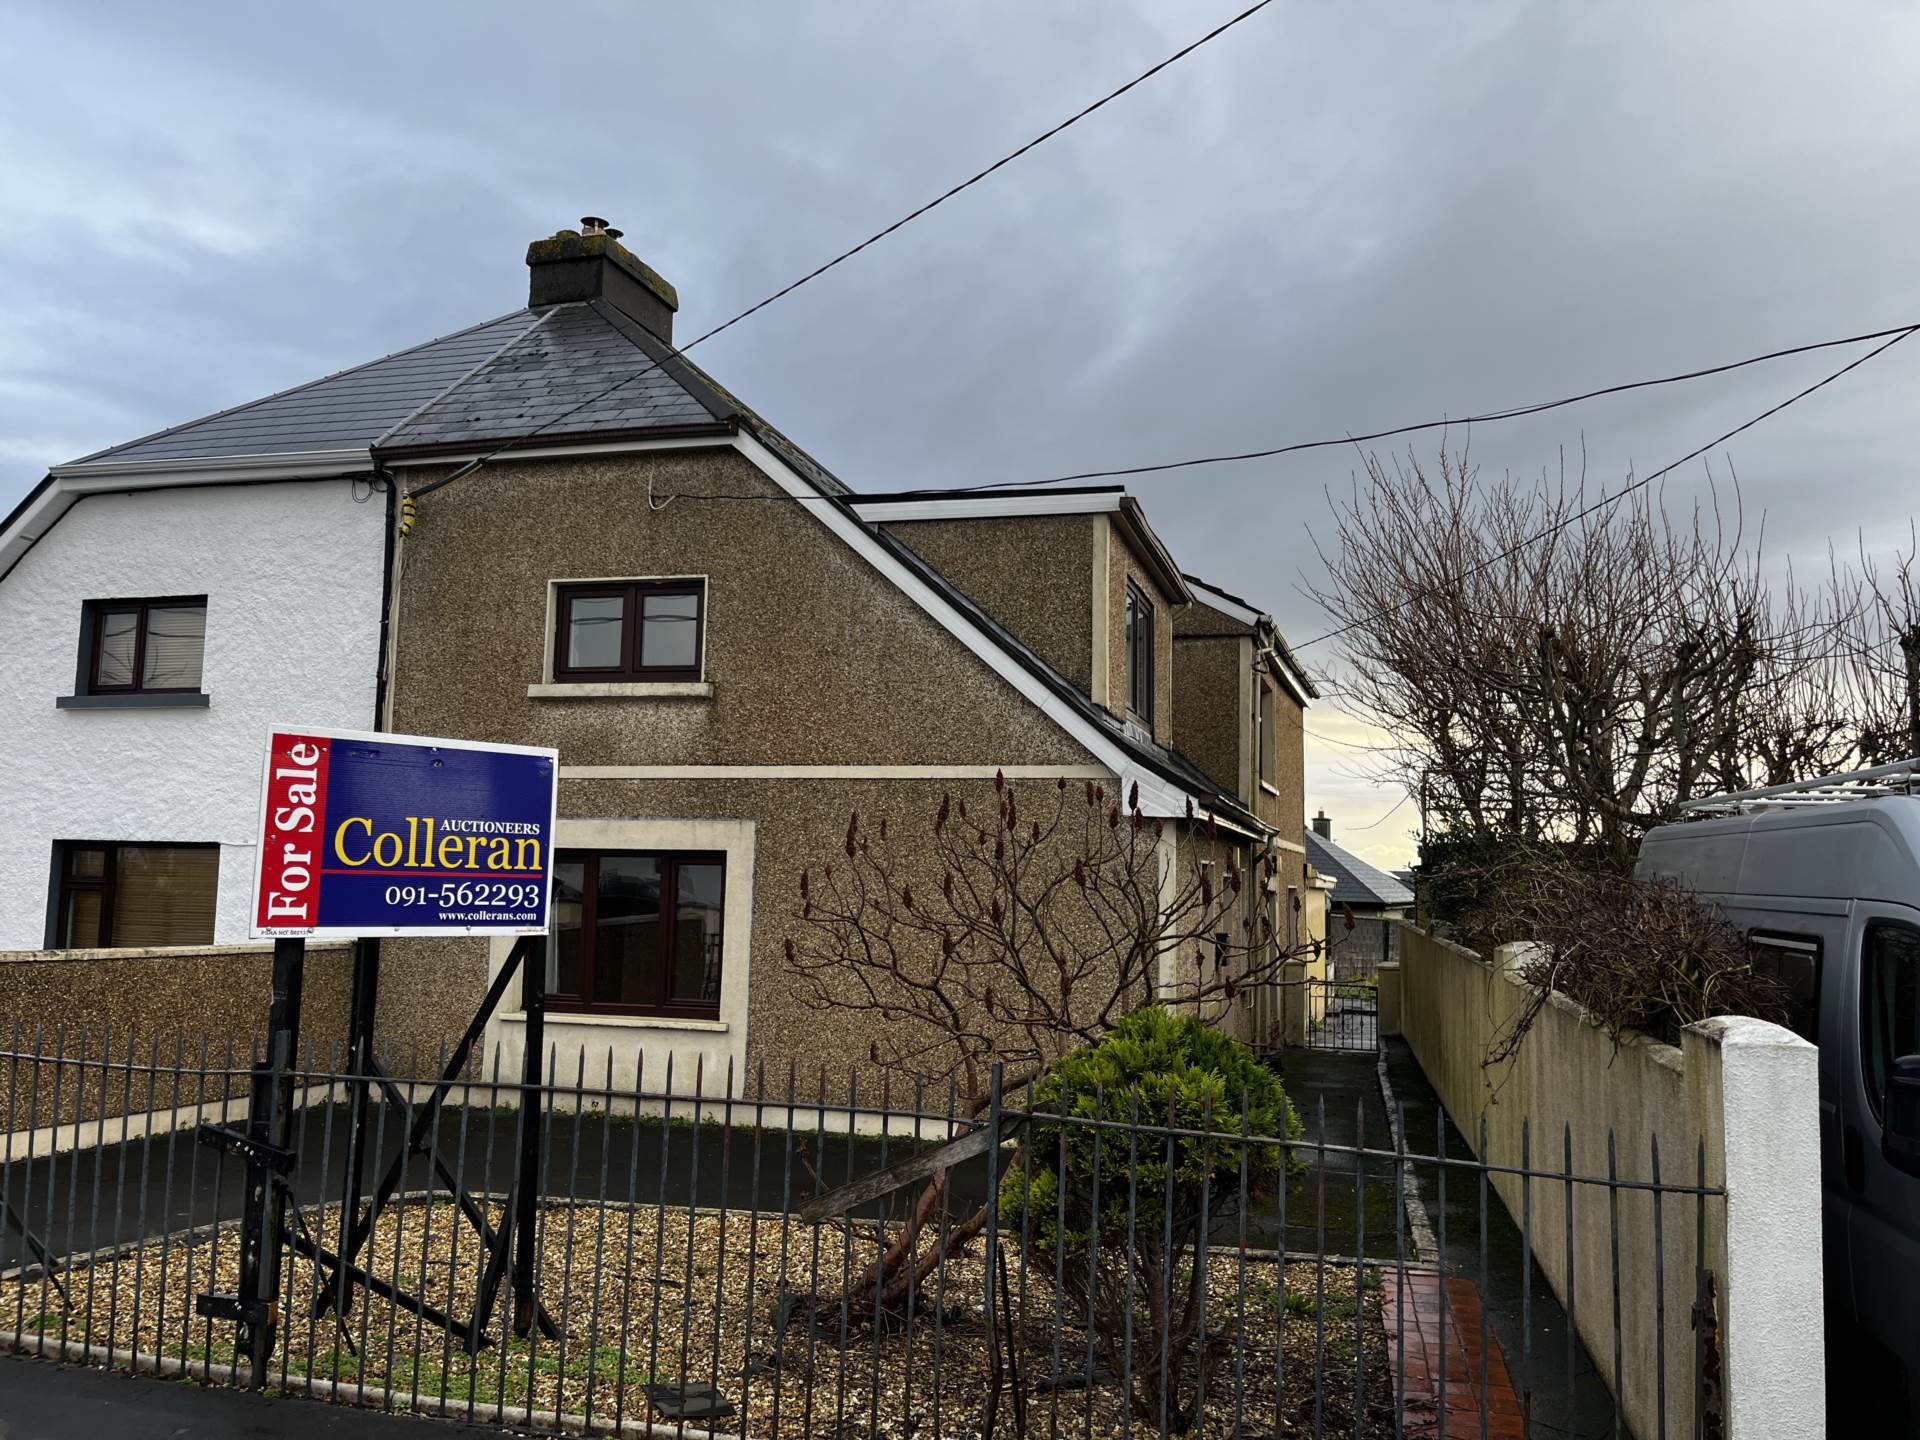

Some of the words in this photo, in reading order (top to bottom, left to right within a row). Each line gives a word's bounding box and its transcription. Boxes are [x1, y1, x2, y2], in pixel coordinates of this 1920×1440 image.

[275, 743, 319, 833] Sale
[334, 817, 543, 870] Colleran
[440, 819, 540, 835] AUCTIONEERS
[268, 843, 311, 920] For
[385, 882, 539, 908] 091-562293
[438, 911, 537, 921] www.collerans.com
